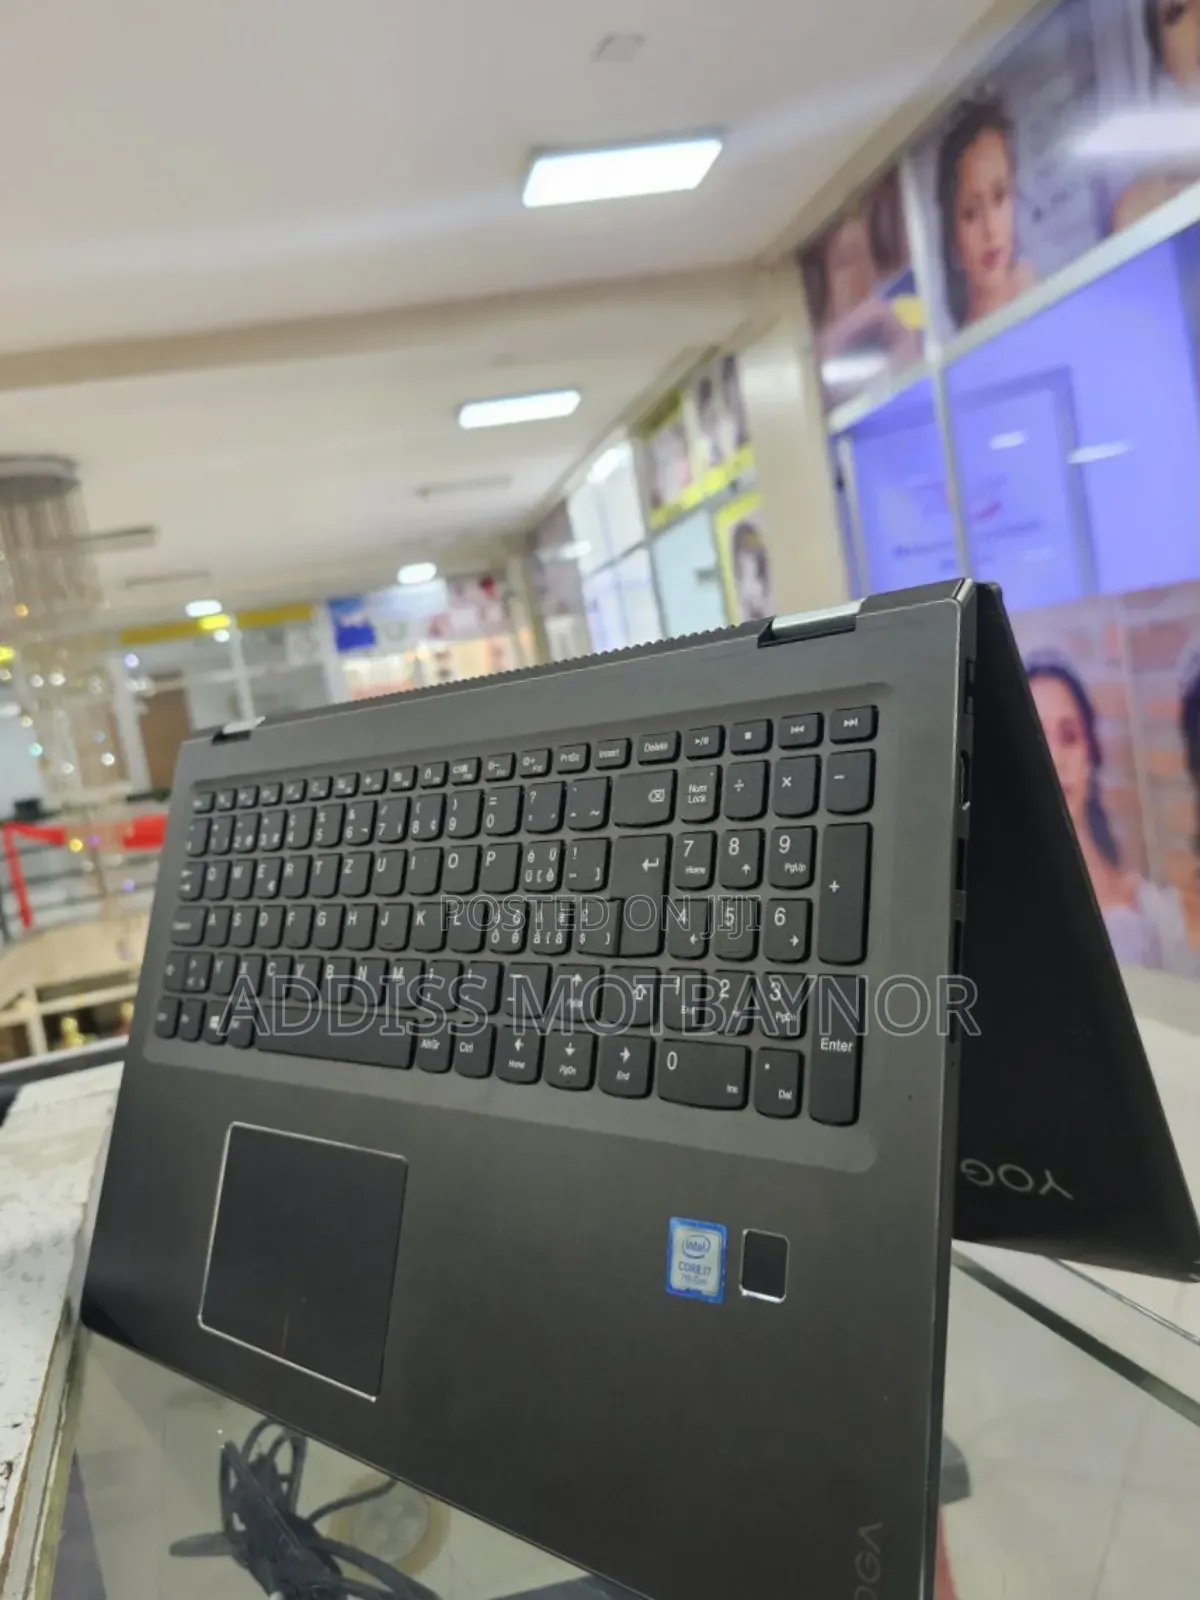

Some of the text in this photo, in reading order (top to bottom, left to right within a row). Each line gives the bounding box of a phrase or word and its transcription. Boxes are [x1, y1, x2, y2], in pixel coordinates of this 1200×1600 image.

[643, 741, 669, 753] Delete
[688, 784, 708, 794] Num
[687, 794, 707, 804] Lock
[412, 819, 420, 834] 8
[448, 816, 457, 831] 9
[486, 813, 495, 828] 0
[379, 822, 387, 836] 7
[683, 840, 695, 858] 7
[728, 837, 740, 855] 8
[778, 835, 791, 853] 9
[343, 859, 354, 874] Z
[376, 857, 387, 872] U
[448, 853, 459, 869] O
[485, 850, 496, 867] P
[257, 863, 267, 878] E
[285, 862, 294, 877] R
[315, 860, 324, 875] T
[784, 863, 807, 875] PgUp
[233, 912, 242, 928] S
[259, 911, 269, 928] D
[286, 911, 296, 927] F
[317, 911, 327, 927] G
[347, 911, 358, 926] H
[381, 910, 390, 926] J
[416, 909, 427, 926] K
[677, 908, 687, 925] 4
[724, 907, 735, 926] 5
[774, 907, 786, 926] 6
[267, 962, 277, 977] C
[325, 964, 335, 980] B
[357, 965, 368, 981] N
[392, 966, 404, 982] M
[720, 979, 730, 998] 2
[769, 981, 781, 1001] 3
[459, 1041, 474, 1053] Ctrl
[820, 1037, 854, 1053] Enter
[666, 1051, 678, 1070] 0
[616, 1070, 631, 1081] End
[726, 1083, 738, 1094] Ins
[778, 1089, 793, 1100] Del
[960, 1158, 1074, 1201] YOG
[685, 1240, 706, 1252] intel
[678, 1261, 701, 1275] CORE
